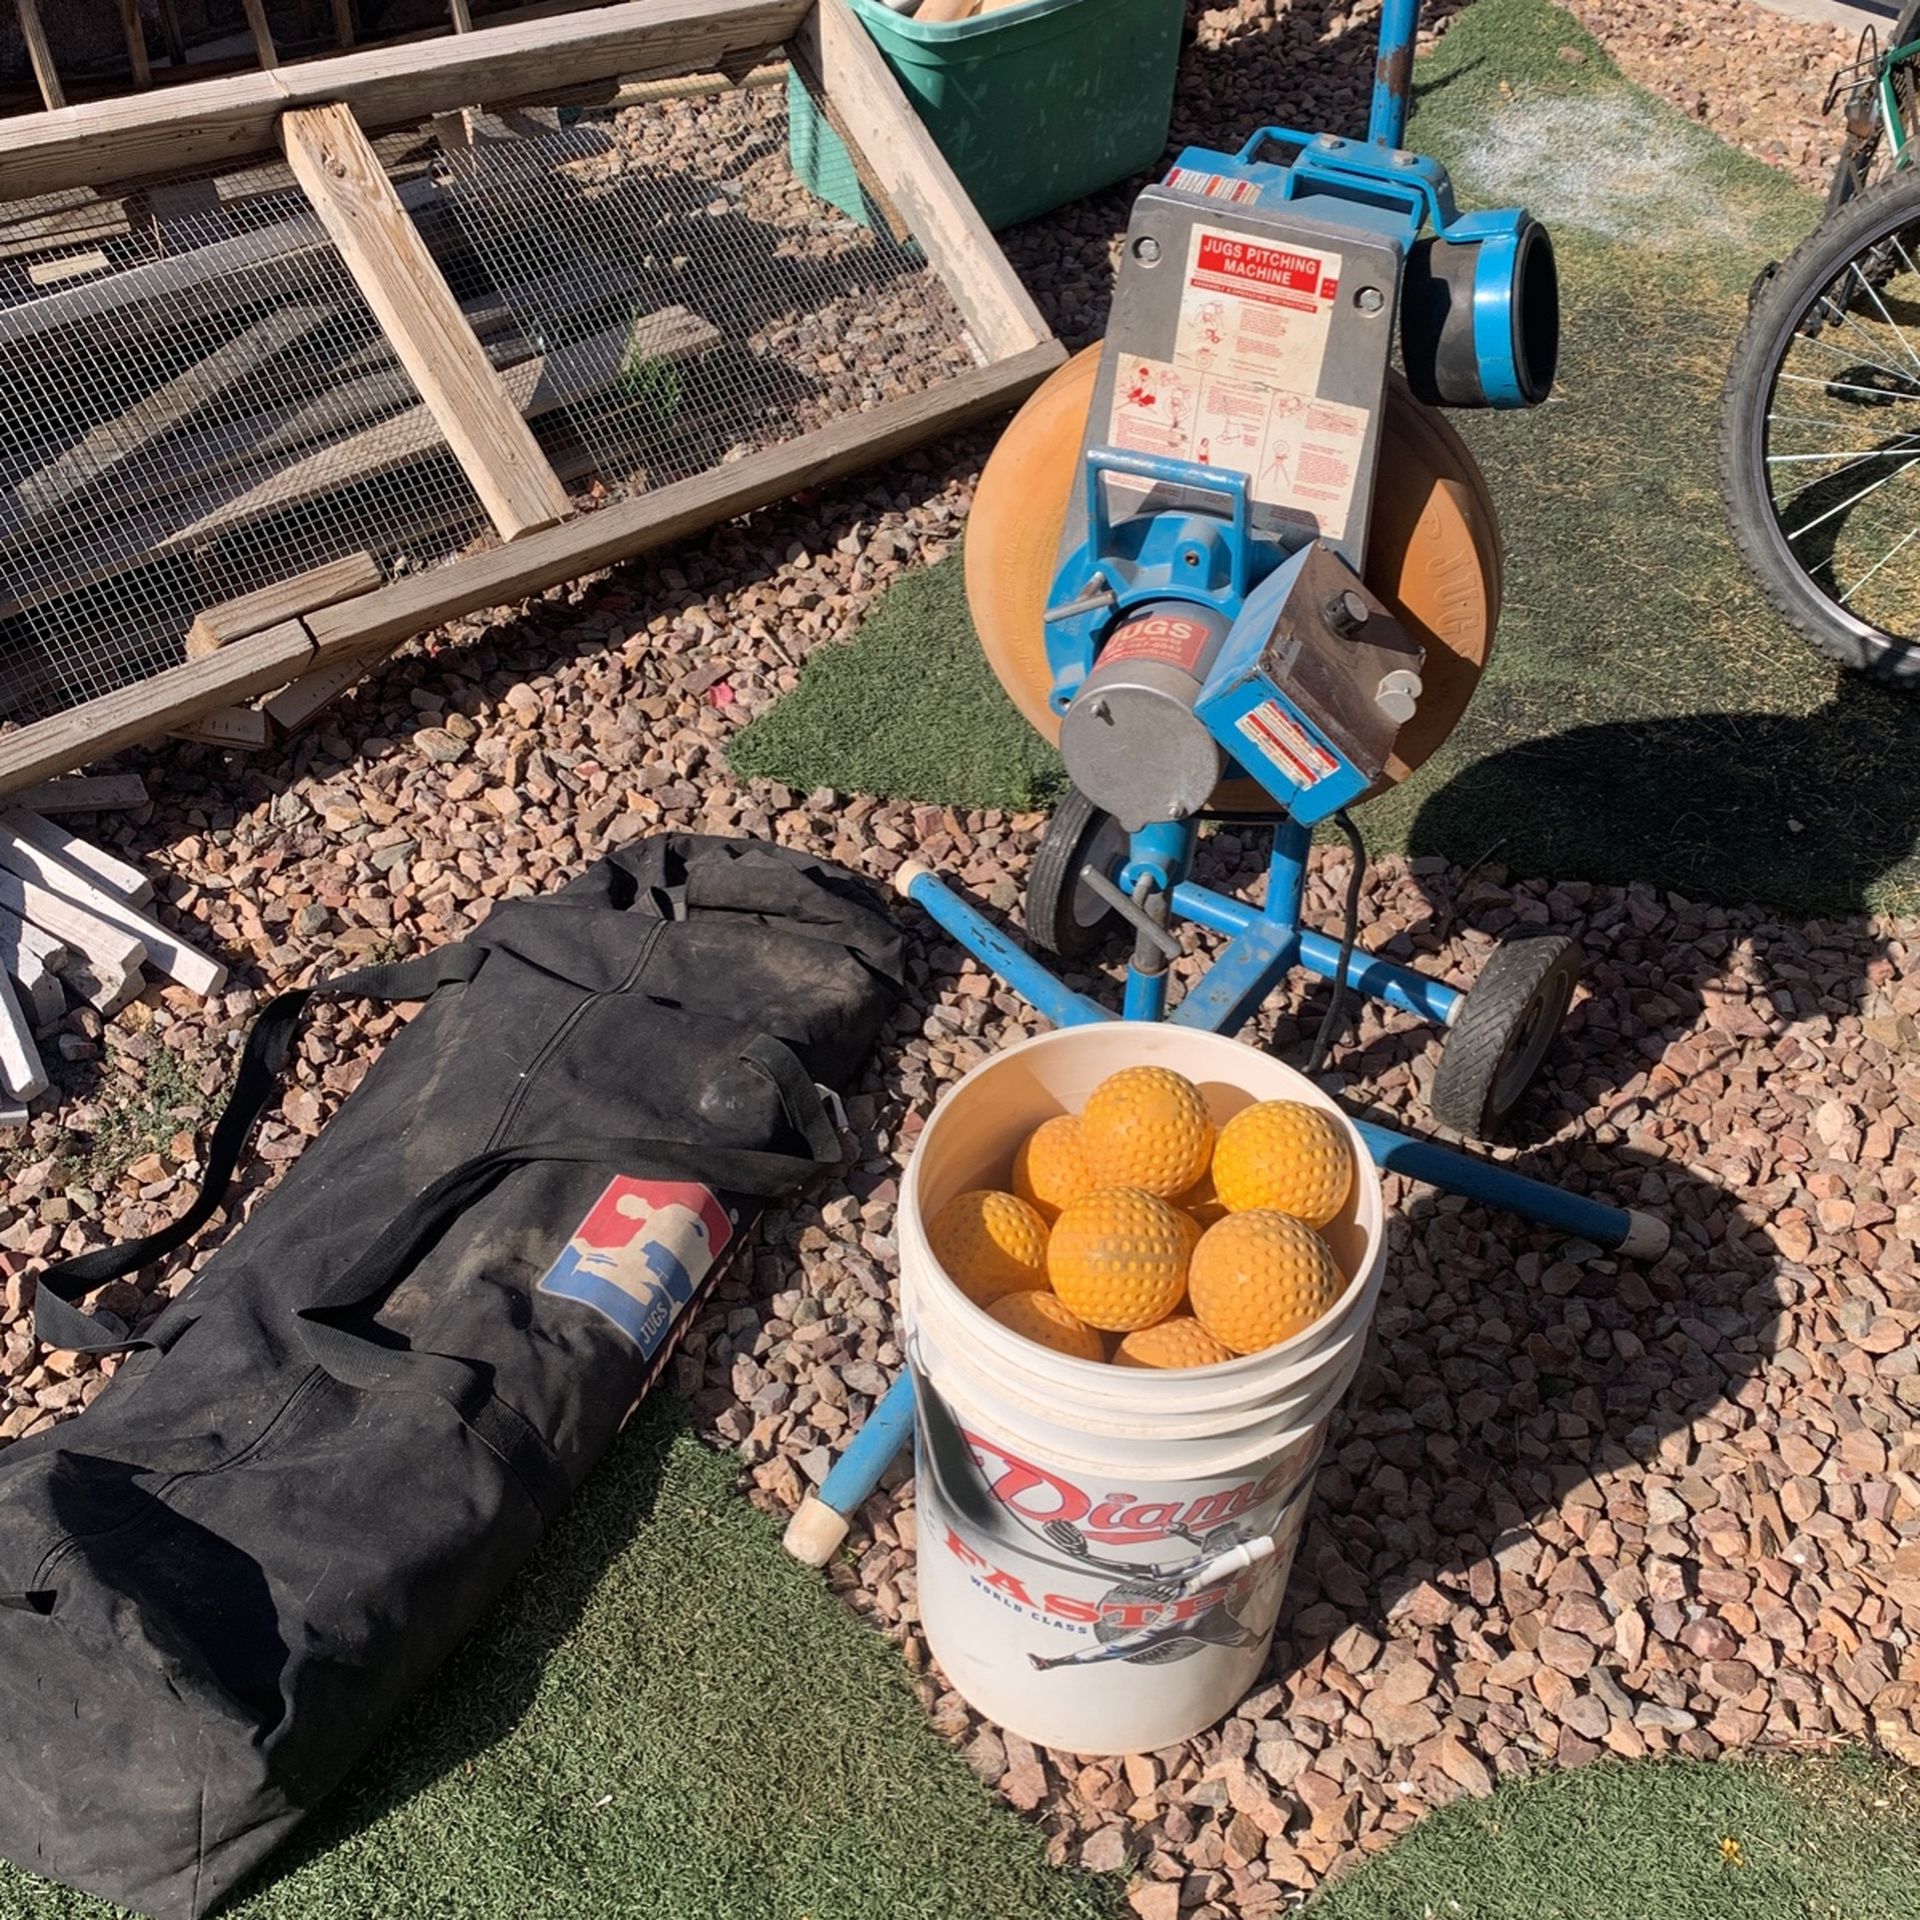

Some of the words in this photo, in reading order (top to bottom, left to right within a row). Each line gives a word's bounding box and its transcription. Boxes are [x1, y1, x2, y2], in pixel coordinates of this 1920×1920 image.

[1204, 239, 1243, 258] JUGS
[1246, 248, 1318, 274] PITCHING
[1224, 259, 1292, 285] MACHINE
[640, 1302, 668, 1344] JUGS
[970, 1575, 1023, 1613] WORLD
[1031, 1612, 1088, 1634] CLASS
